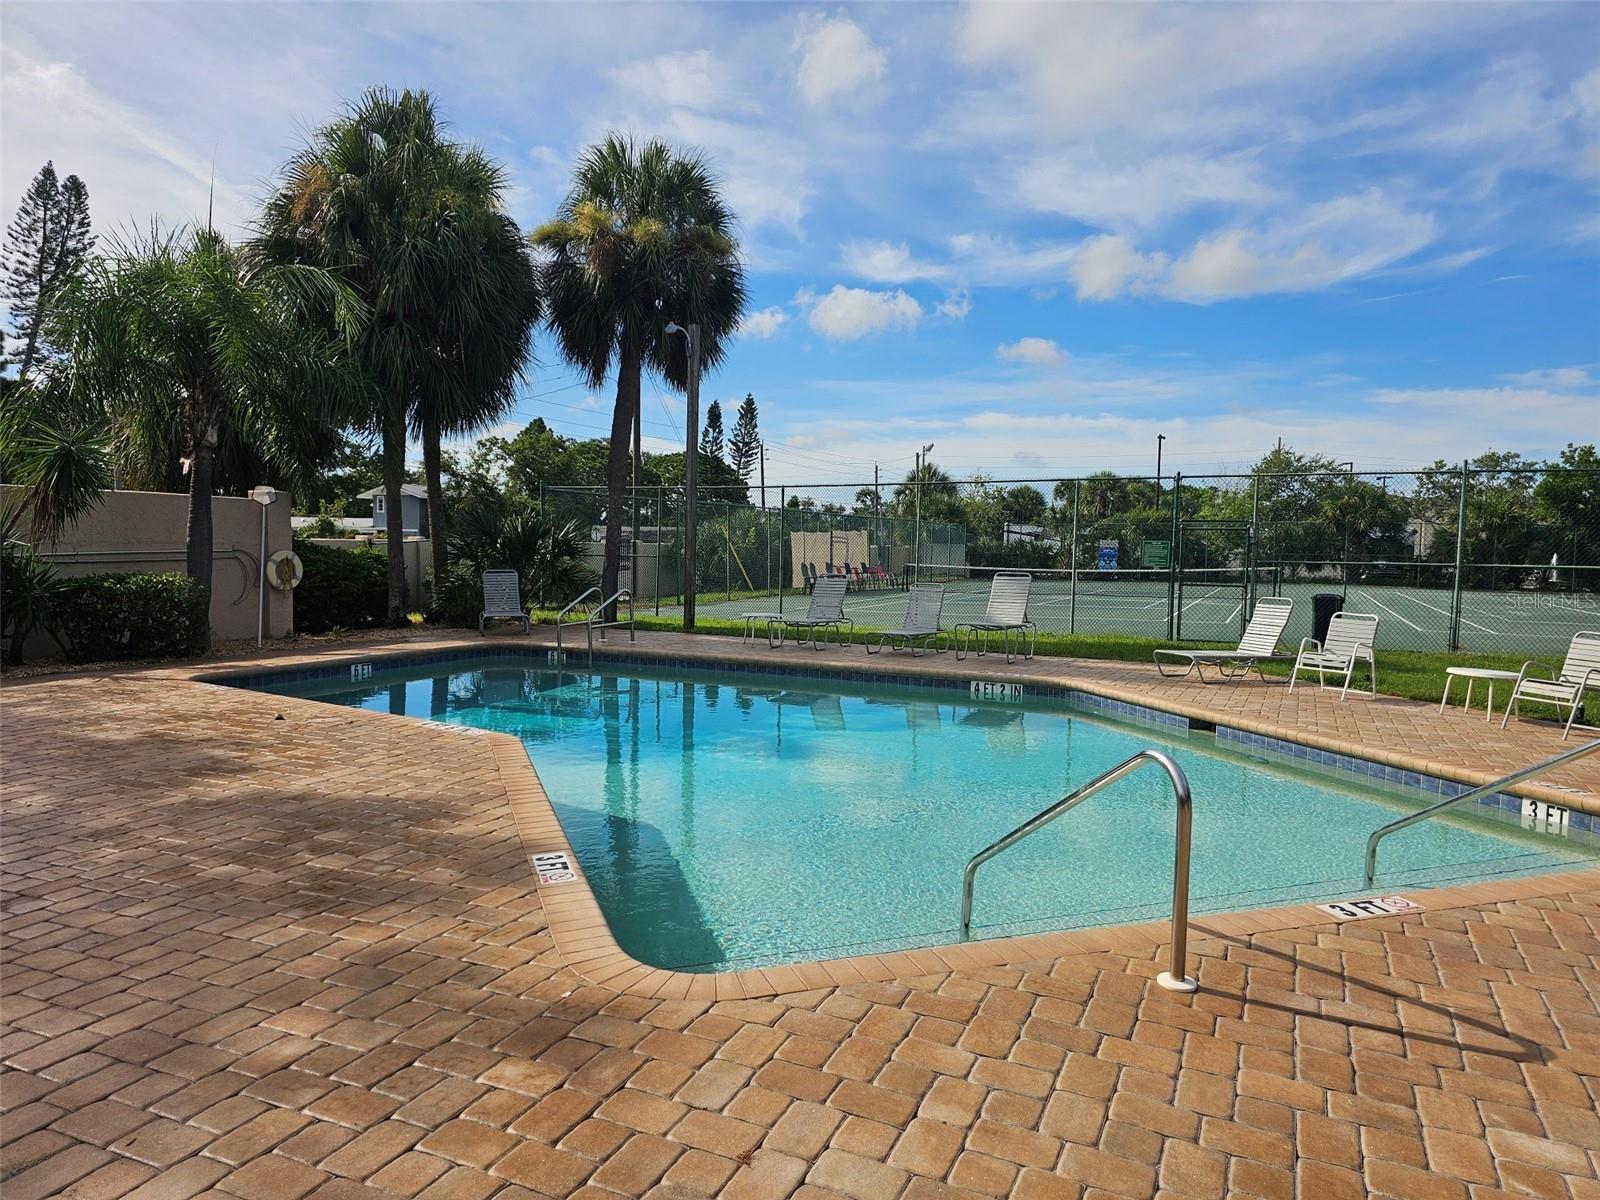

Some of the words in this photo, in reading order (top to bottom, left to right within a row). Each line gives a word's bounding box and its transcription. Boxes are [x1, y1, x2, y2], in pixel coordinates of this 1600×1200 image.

[1528, 800, 1538, 818] 3
[1546, 804, 1568, 825] FT
[535, 854, 565, 862] 3
[536, 861, 571, 873] FT
[1328, 904, 1358, 917] 3
[1348, 900, 1391, 915] FT
